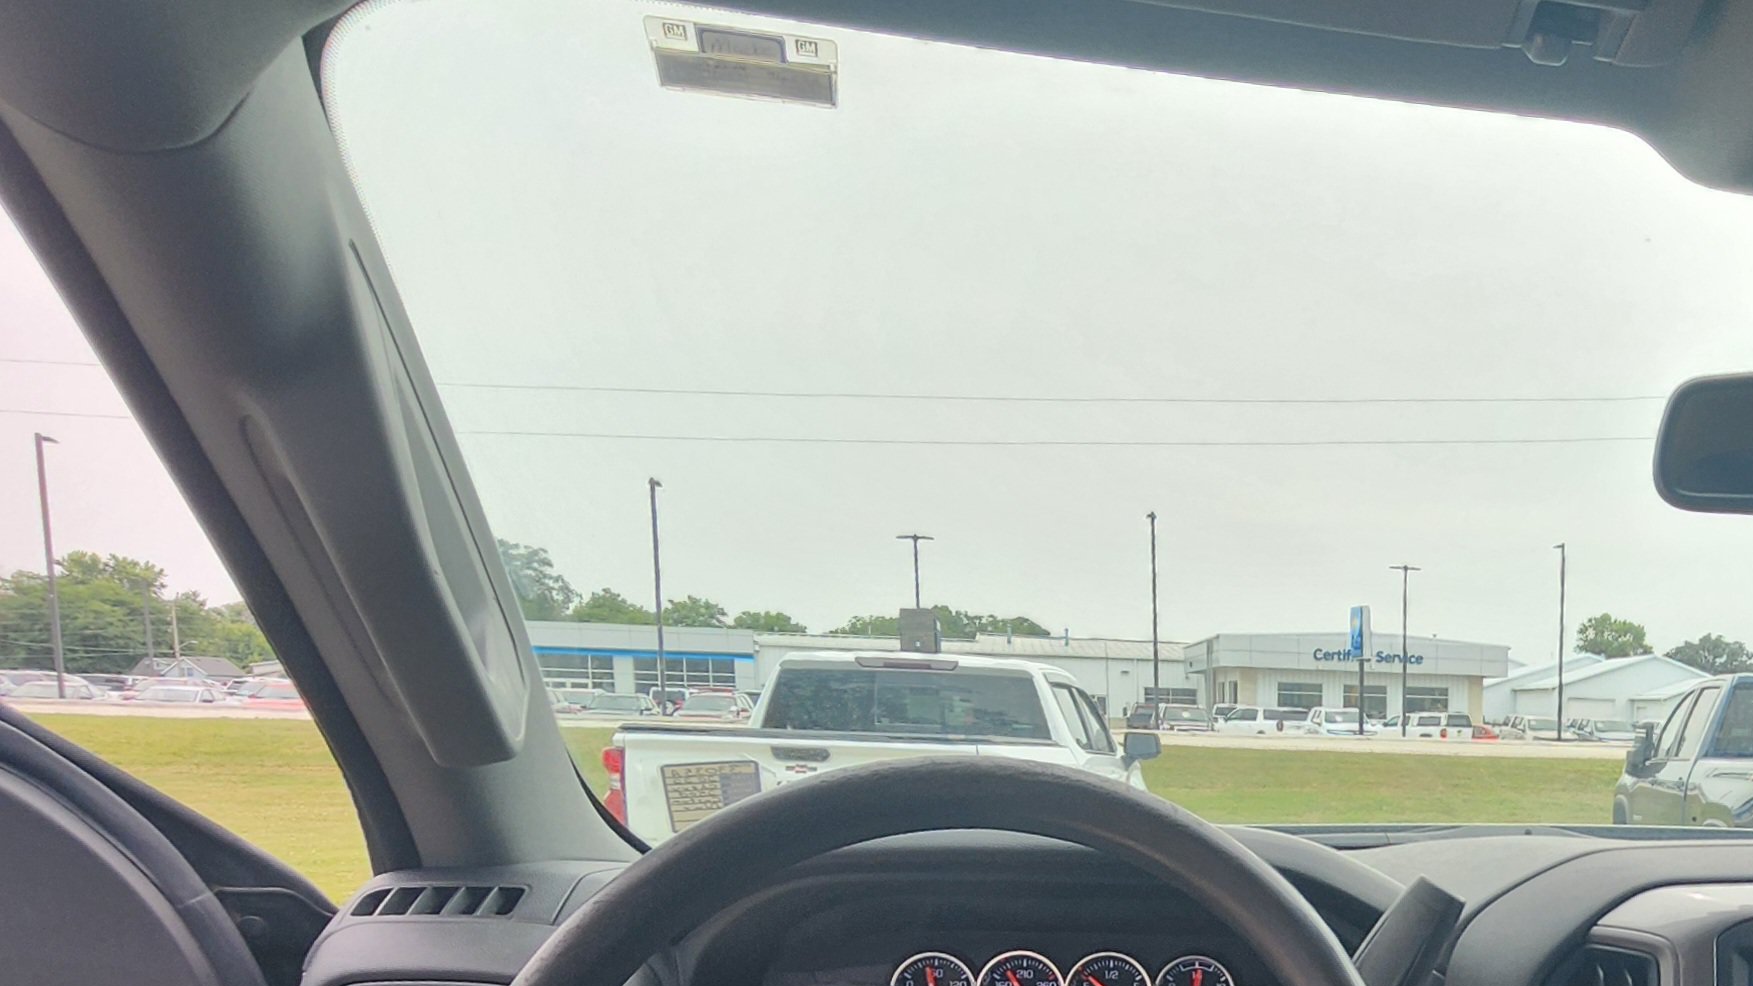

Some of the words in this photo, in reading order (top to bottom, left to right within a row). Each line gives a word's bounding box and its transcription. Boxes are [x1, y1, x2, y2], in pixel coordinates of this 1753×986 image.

[664, 23, 686, 39] GM
[797, 40, 817, 56] GM
[1016, 969, 1034, 979] 210
[1104, 970, 1119, 980] 1/2
